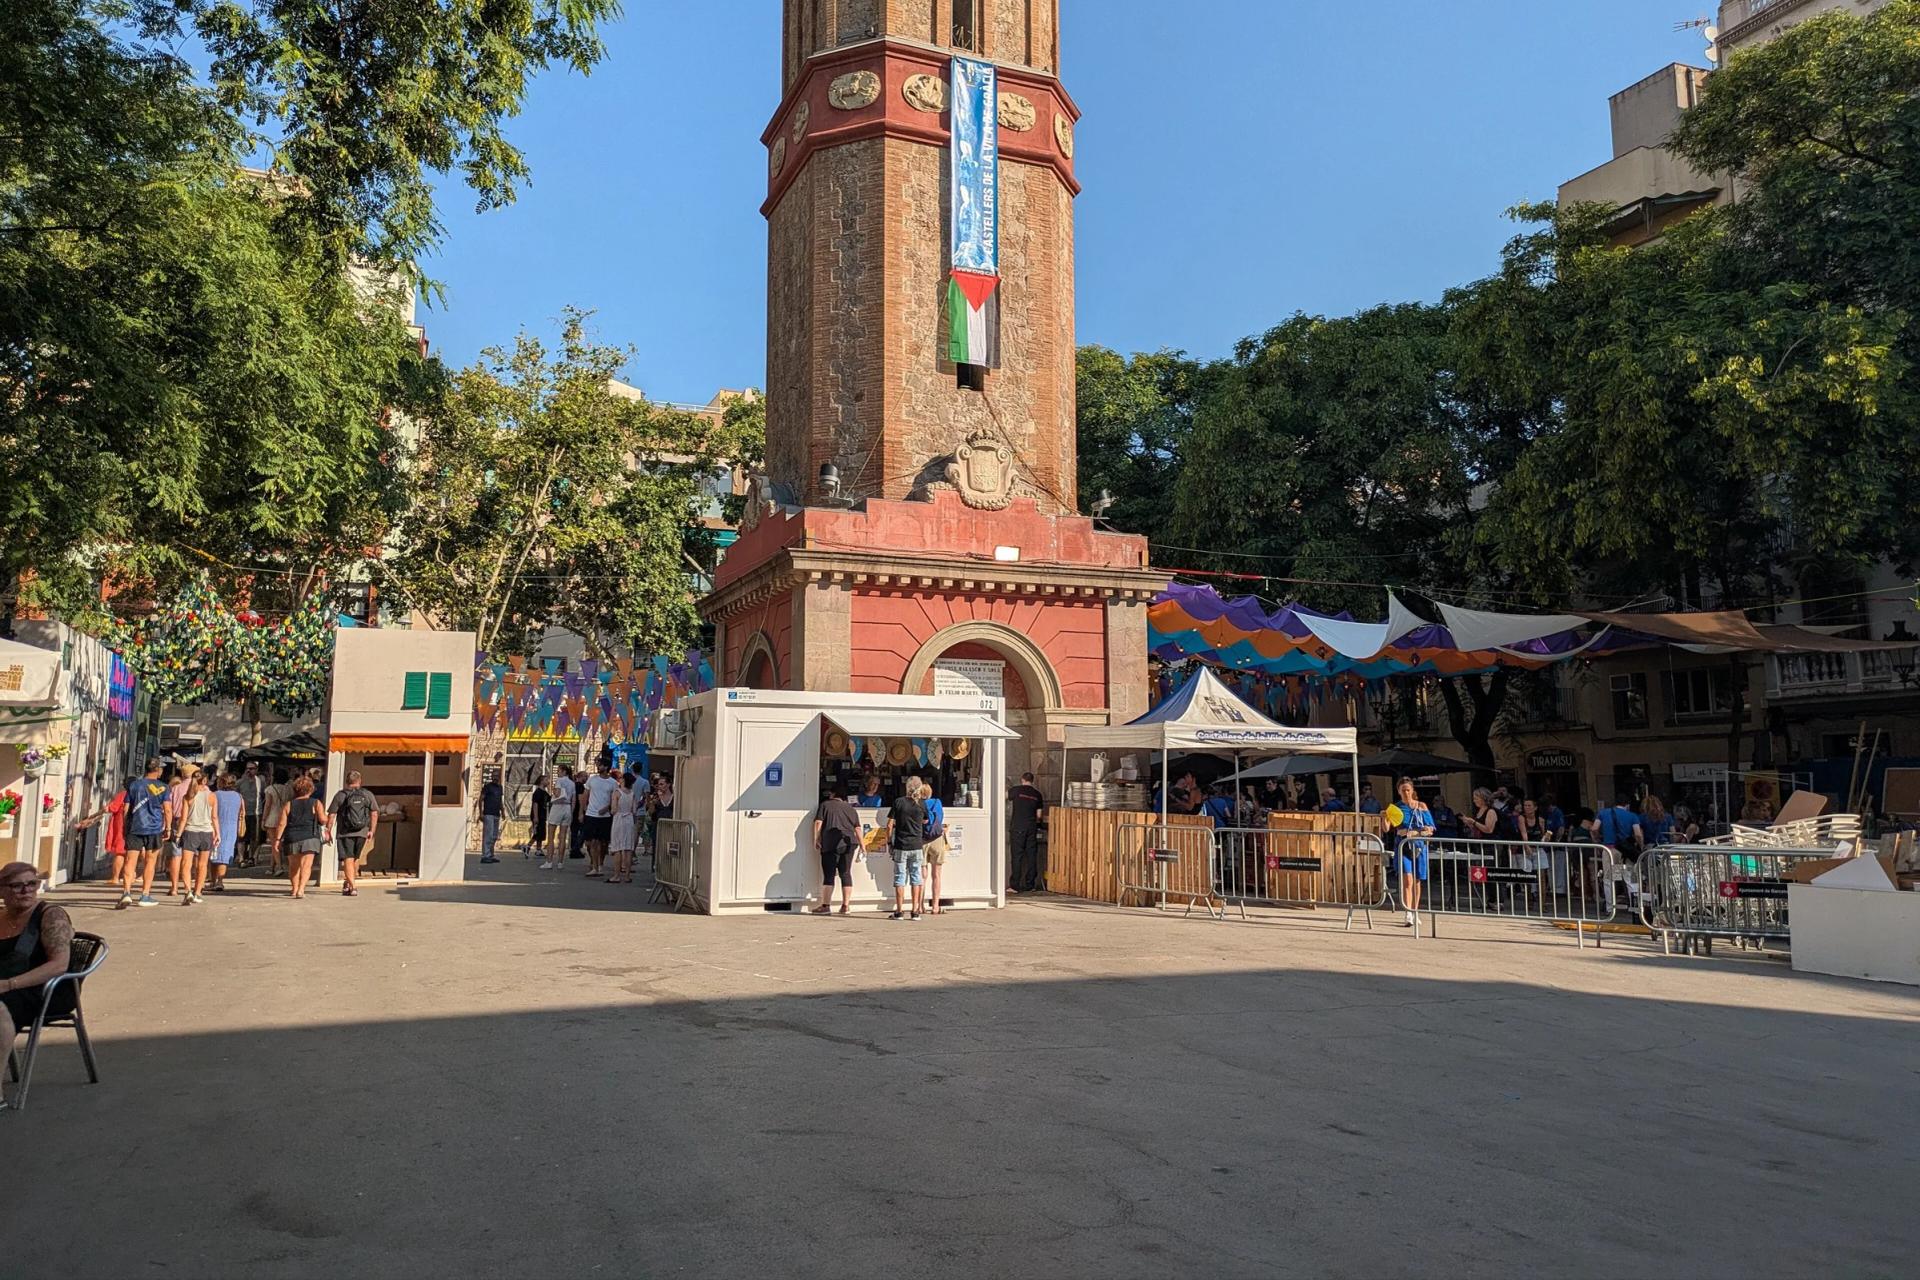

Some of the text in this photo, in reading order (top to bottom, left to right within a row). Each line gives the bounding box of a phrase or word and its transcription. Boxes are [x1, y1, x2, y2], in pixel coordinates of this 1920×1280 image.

[984, 126, 993, 151] VILA
[984, 155, 993, 169] LA
[983, 173, 993, 186] DE
[983, 188, 993, 255] CASTELLERS
[980, 700, 993, 709] 072
[1532, 755, 1572, 767] TIRAMISU
